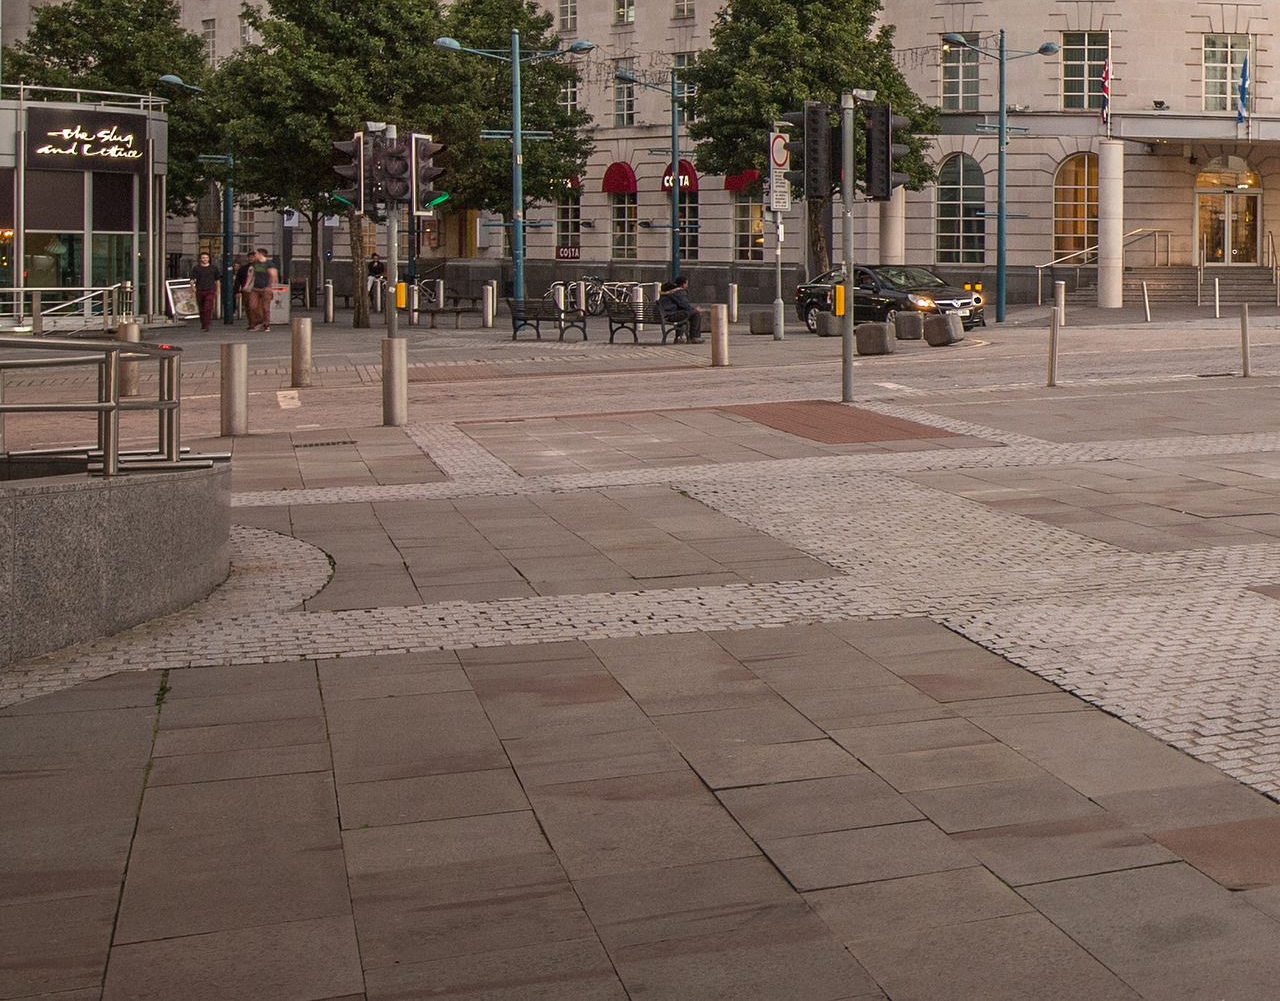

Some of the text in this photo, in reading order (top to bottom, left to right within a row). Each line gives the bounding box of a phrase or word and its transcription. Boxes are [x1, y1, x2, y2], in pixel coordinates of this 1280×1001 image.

[47, 125, 96, 140] the
[36, 142, 78, 155] and
[664, 175, 690, 187] COTA
[559, 248, 579, 258] COSTA
